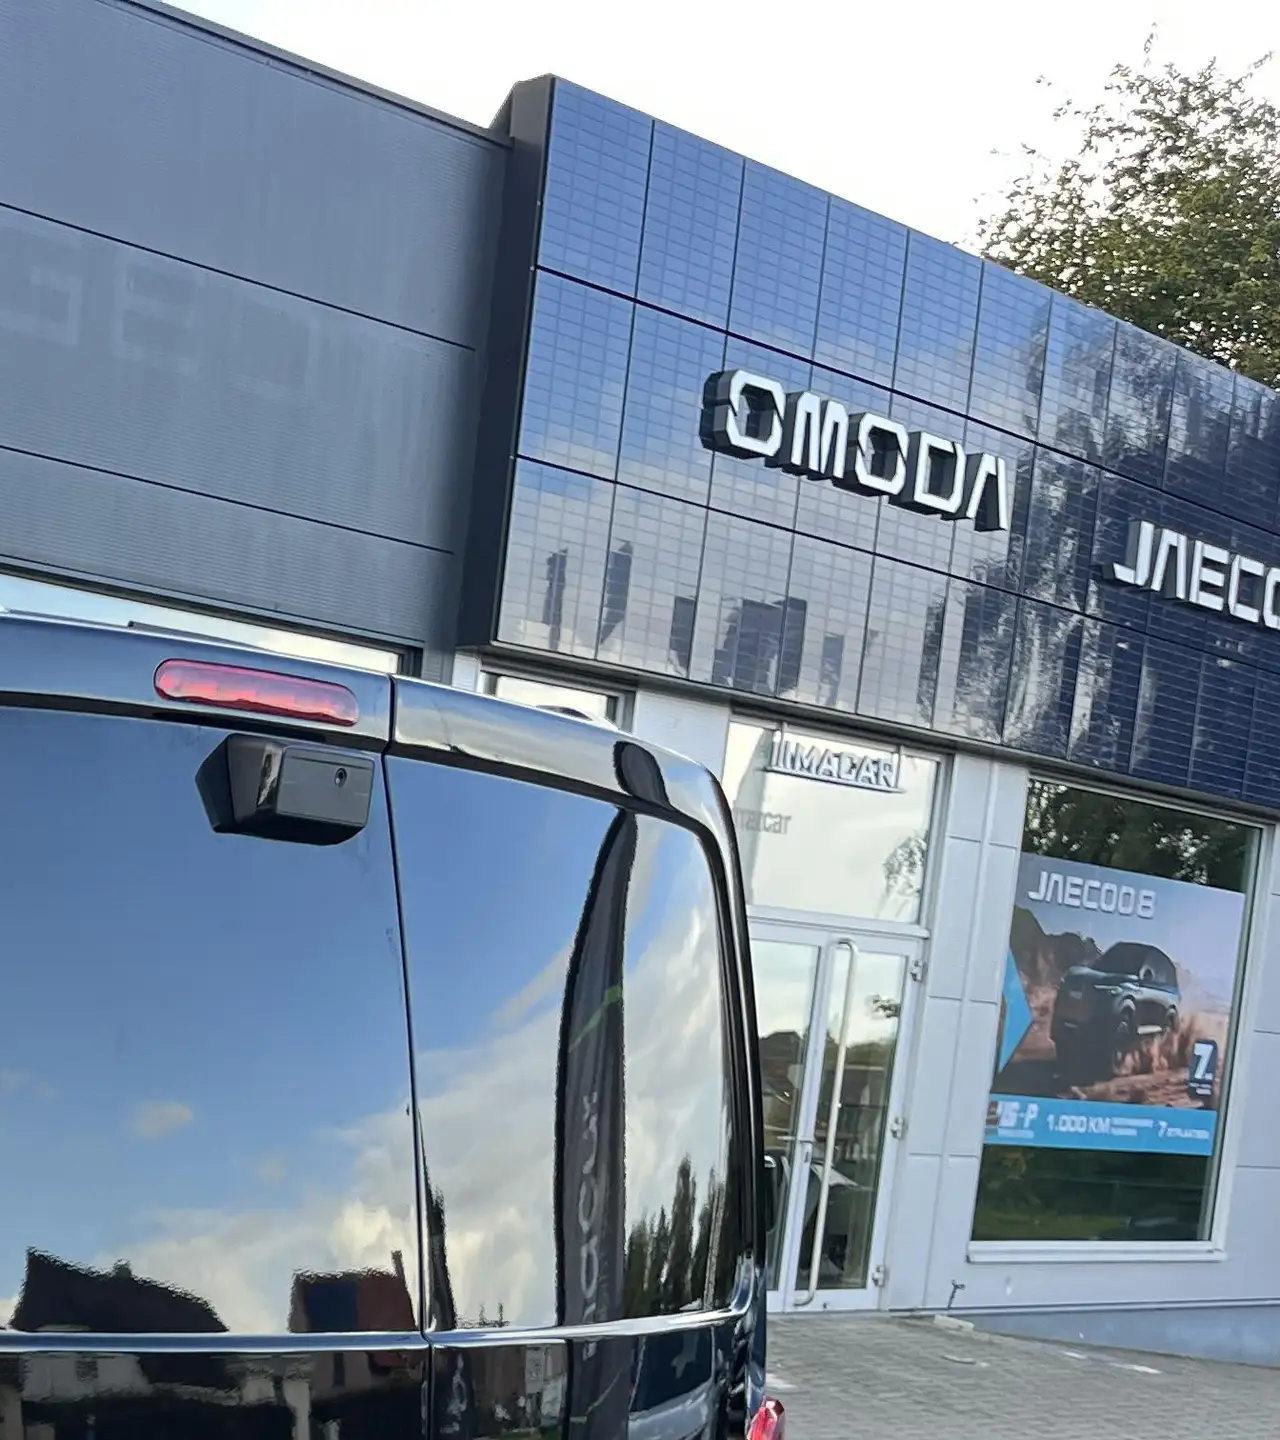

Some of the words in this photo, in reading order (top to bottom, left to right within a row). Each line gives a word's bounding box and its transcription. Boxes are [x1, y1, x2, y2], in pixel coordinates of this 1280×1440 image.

[708, 368, 1008, 531] OMODA
[782, 741, 894, 788] IMACAR
[1046, 1114, 1087, 1133] 1.000
